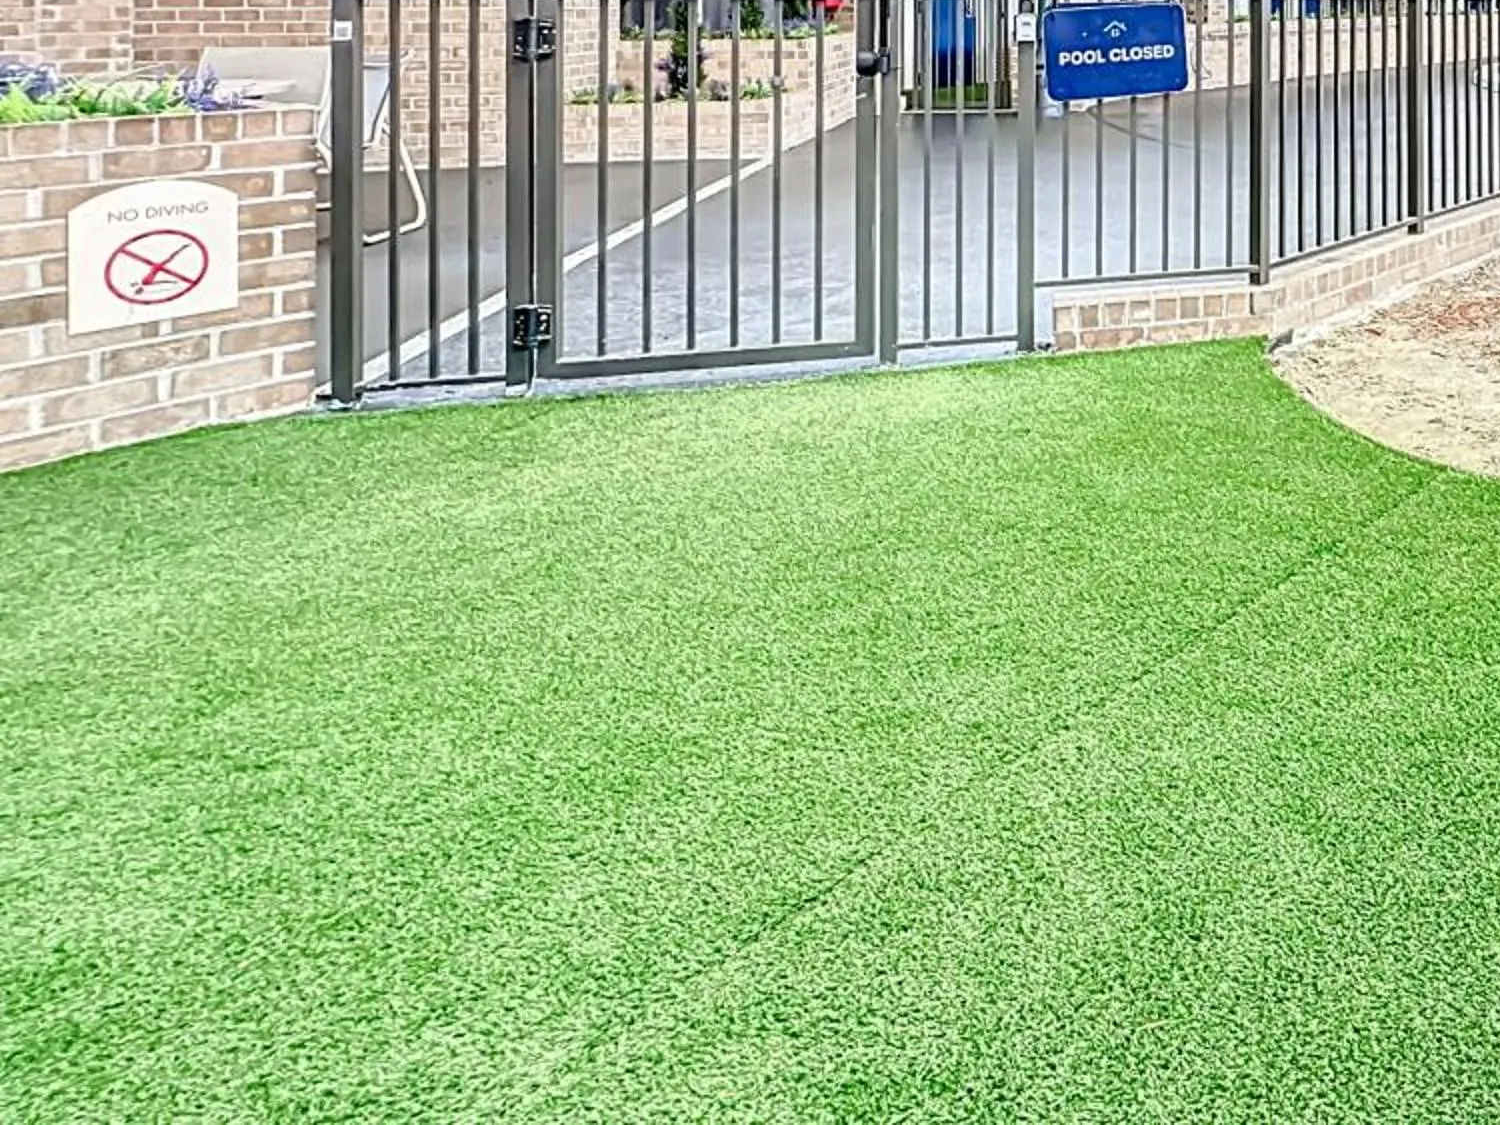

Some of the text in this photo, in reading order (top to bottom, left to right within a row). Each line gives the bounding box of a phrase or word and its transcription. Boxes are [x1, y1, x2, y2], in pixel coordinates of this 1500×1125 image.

[1059, 44, 1175, 66] POOL CLOSED
[107, 201, 209, 224] NO DIVING
